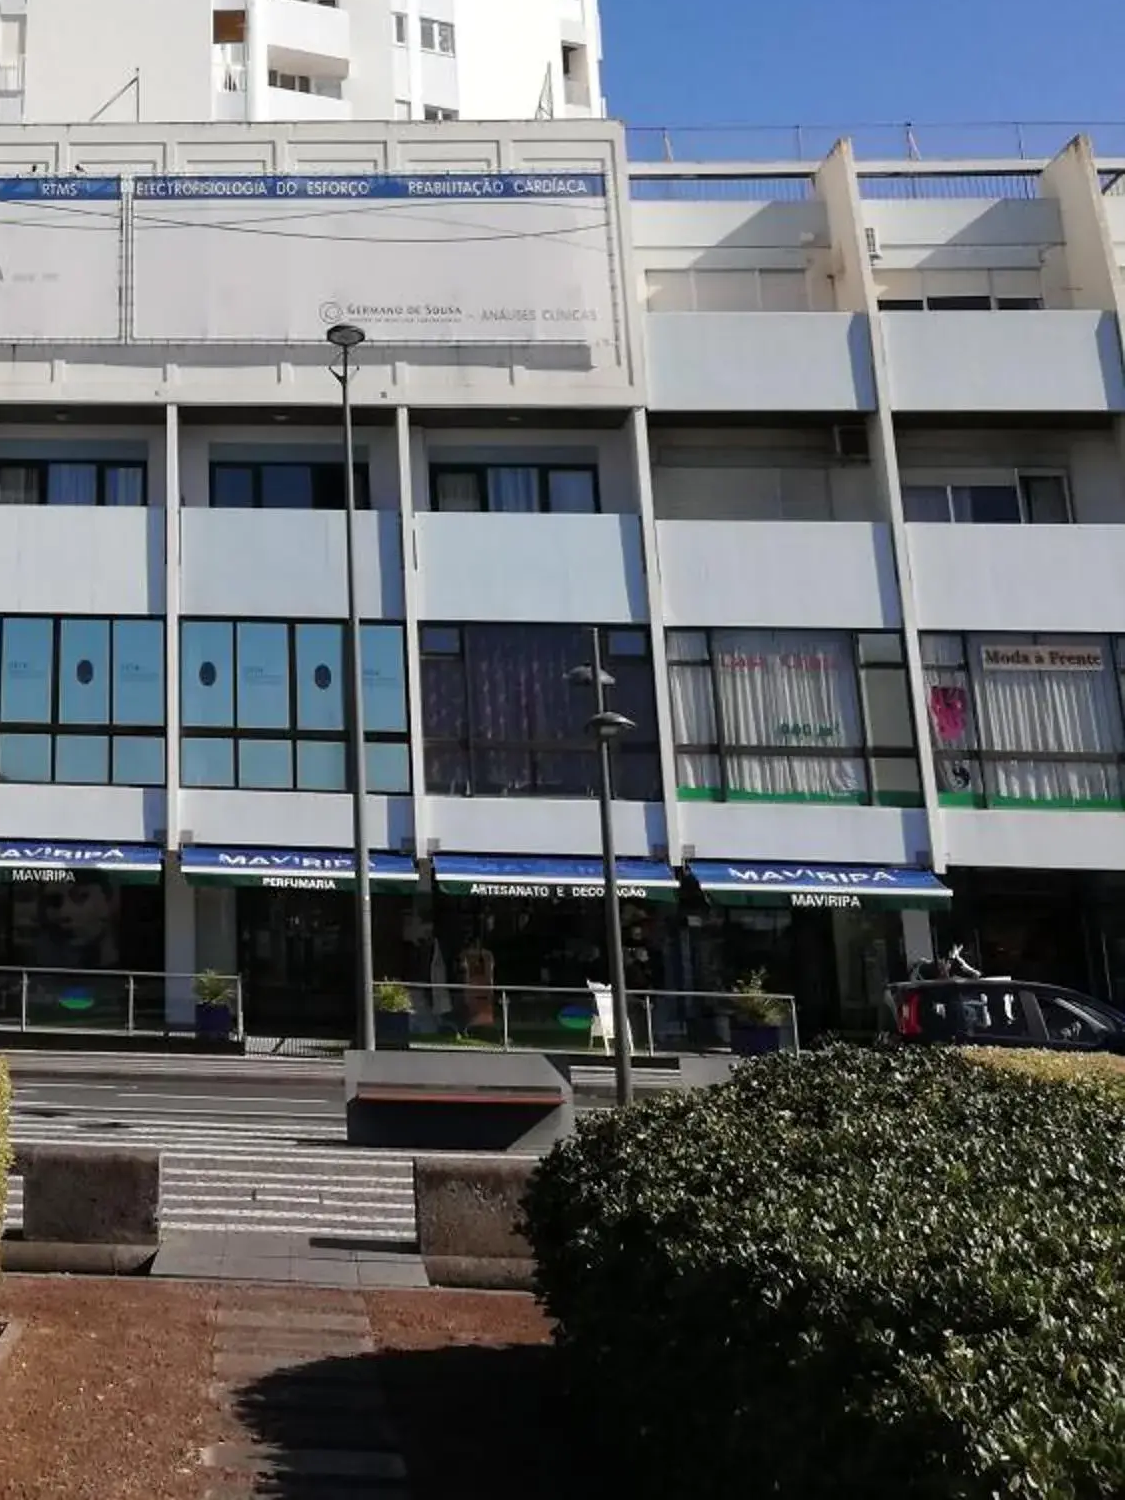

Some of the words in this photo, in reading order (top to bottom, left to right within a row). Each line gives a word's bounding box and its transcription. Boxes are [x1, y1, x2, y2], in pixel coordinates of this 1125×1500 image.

[275, 181, 299, 196] DO
[306, 180, 370, 197] ESFORÇO
[512, 176, 588, 194] CARDÍACA
[11, 868, 76, 883] MAVIRIPA
[262, 876, 337, 890] PERFUMARIA
[470, 883, 549, 898] ARTESANATO
[789, 892, 862, 908] MAVIRIPA
